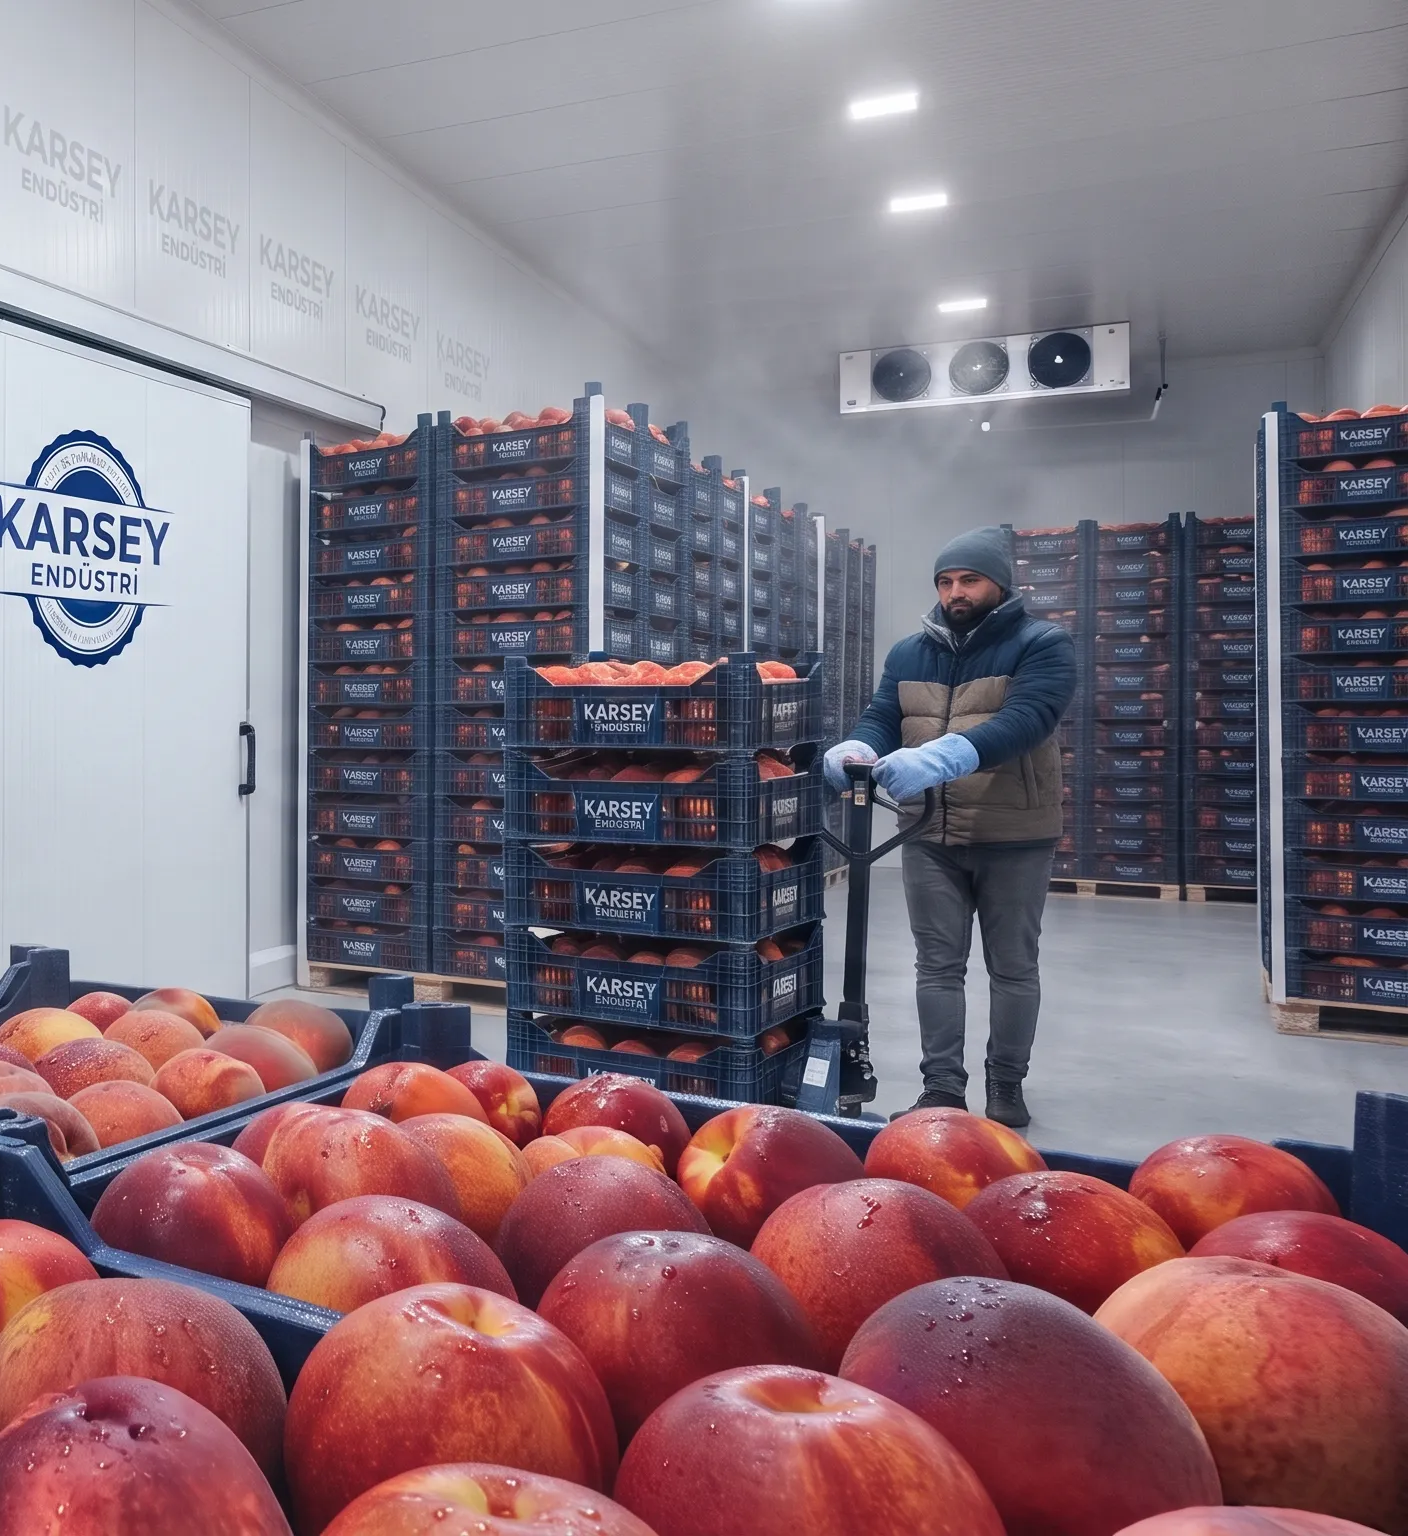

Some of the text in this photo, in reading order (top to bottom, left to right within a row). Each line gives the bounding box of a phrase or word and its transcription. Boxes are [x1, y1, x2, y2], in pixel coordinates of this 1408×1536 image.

[3, 104, 122, 199] KARSEY
[21, 167, 104, 224] ENDÜSTRİ
[148, 178, 240, 256] KARSEY
[161, 232, 226, 279] ENDÜSTRİ
[259, 233, 335, 299] KARSEY
[355, 284, 421, 342] KARSEY
[436, 329, 491, 382] KARSEY
[492, 438, 532, 452] KARSEY
[1339, 427, 1391, 441] KARSEY
[1339, 477, 1392, 490] KARSEY
[1338, 527, 1388, 540] KARSEY
[31, 562, 138, 595] ENDÜSTRİ
[1337, 627, 1386, 639] KARSEY
[1336, 675, 1386, 687] KARSEY
[584, 703, 655, 722] KARSEY
[584, 799, 654, 819] KARSEY
[585, 887, 656, 911] KARSEY
[586, 975, 657, 1000] KARSEY
